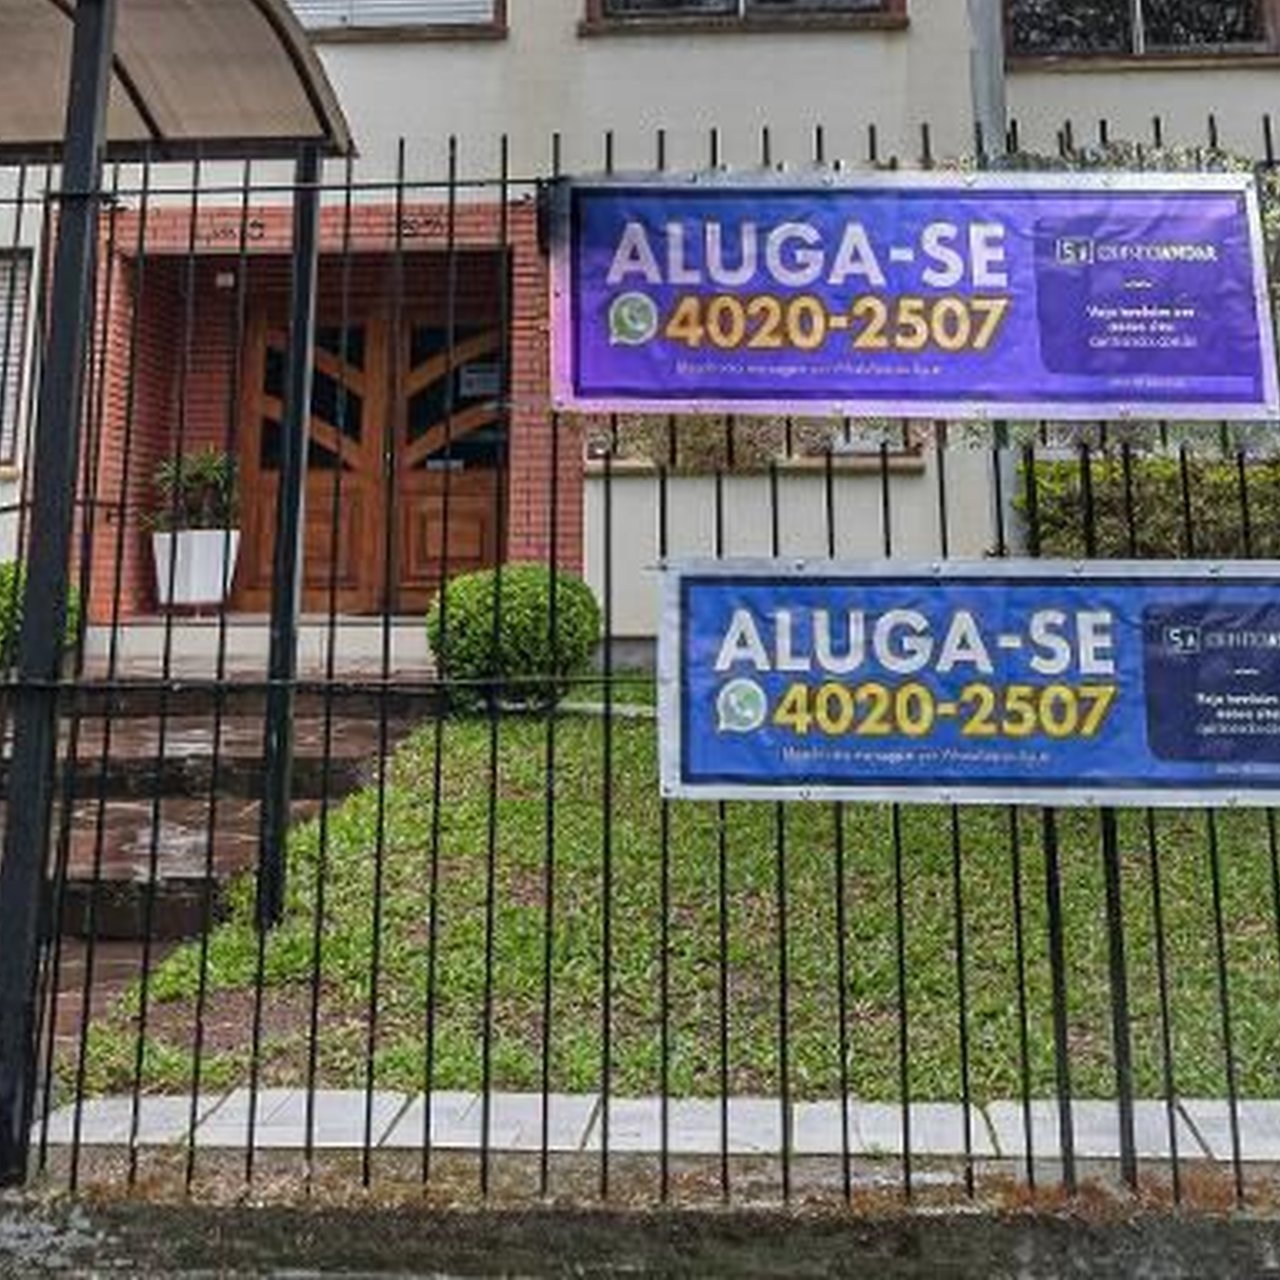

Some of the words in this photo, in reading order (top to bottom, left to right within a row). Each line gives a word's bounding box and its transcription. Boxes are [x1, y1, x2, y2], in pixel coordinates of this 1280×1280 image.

[606, 222, 1010, 288] ALUGA-SE
[666, 295, 1009, 350] 4020-2507
[713, 608, 1116, 674] ALUGA-SE
[773, 683, 1117, 737] 4020-2507
